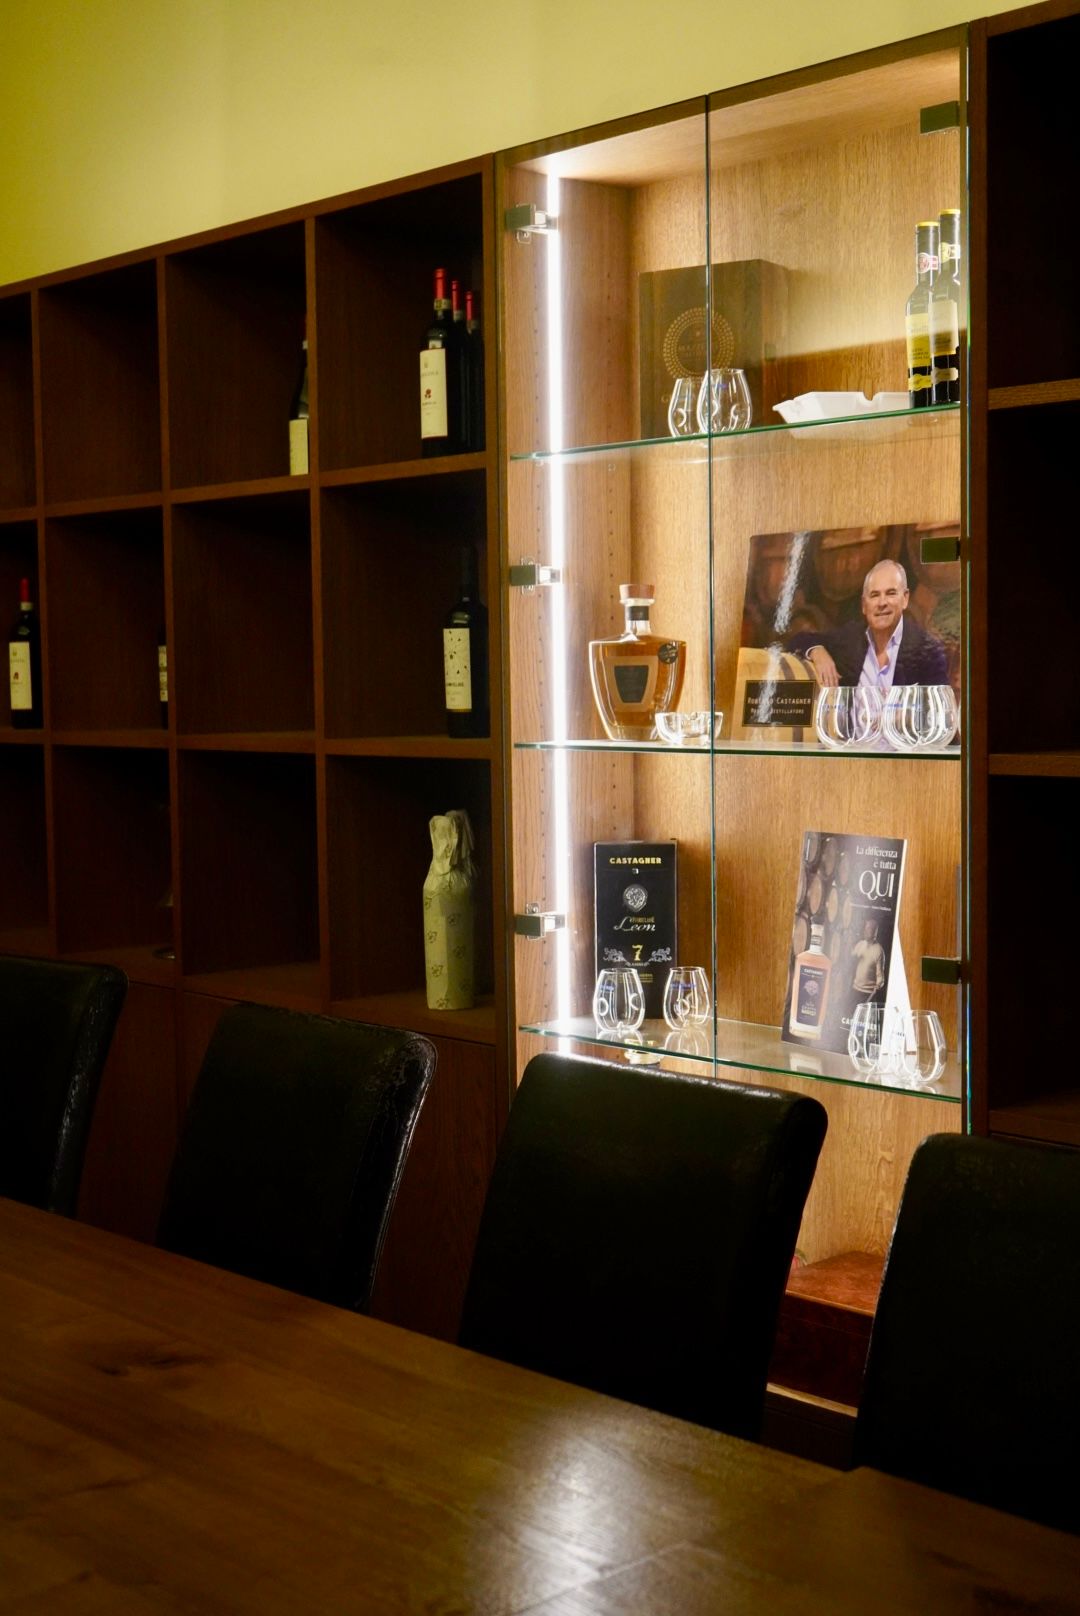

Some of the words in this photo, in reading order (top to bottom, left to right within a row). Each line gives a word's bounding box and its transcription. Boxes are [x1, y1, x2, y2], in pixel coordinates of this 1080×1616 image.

[856, 845, 864, 855] La
[865, 846, 898, 858] differenza
[880, 861, 897, 870] tutta
[859, 870, 895, 901] QUI
[613, 916, 656, 931] Leon
[632, 944, 643, 961] 7
